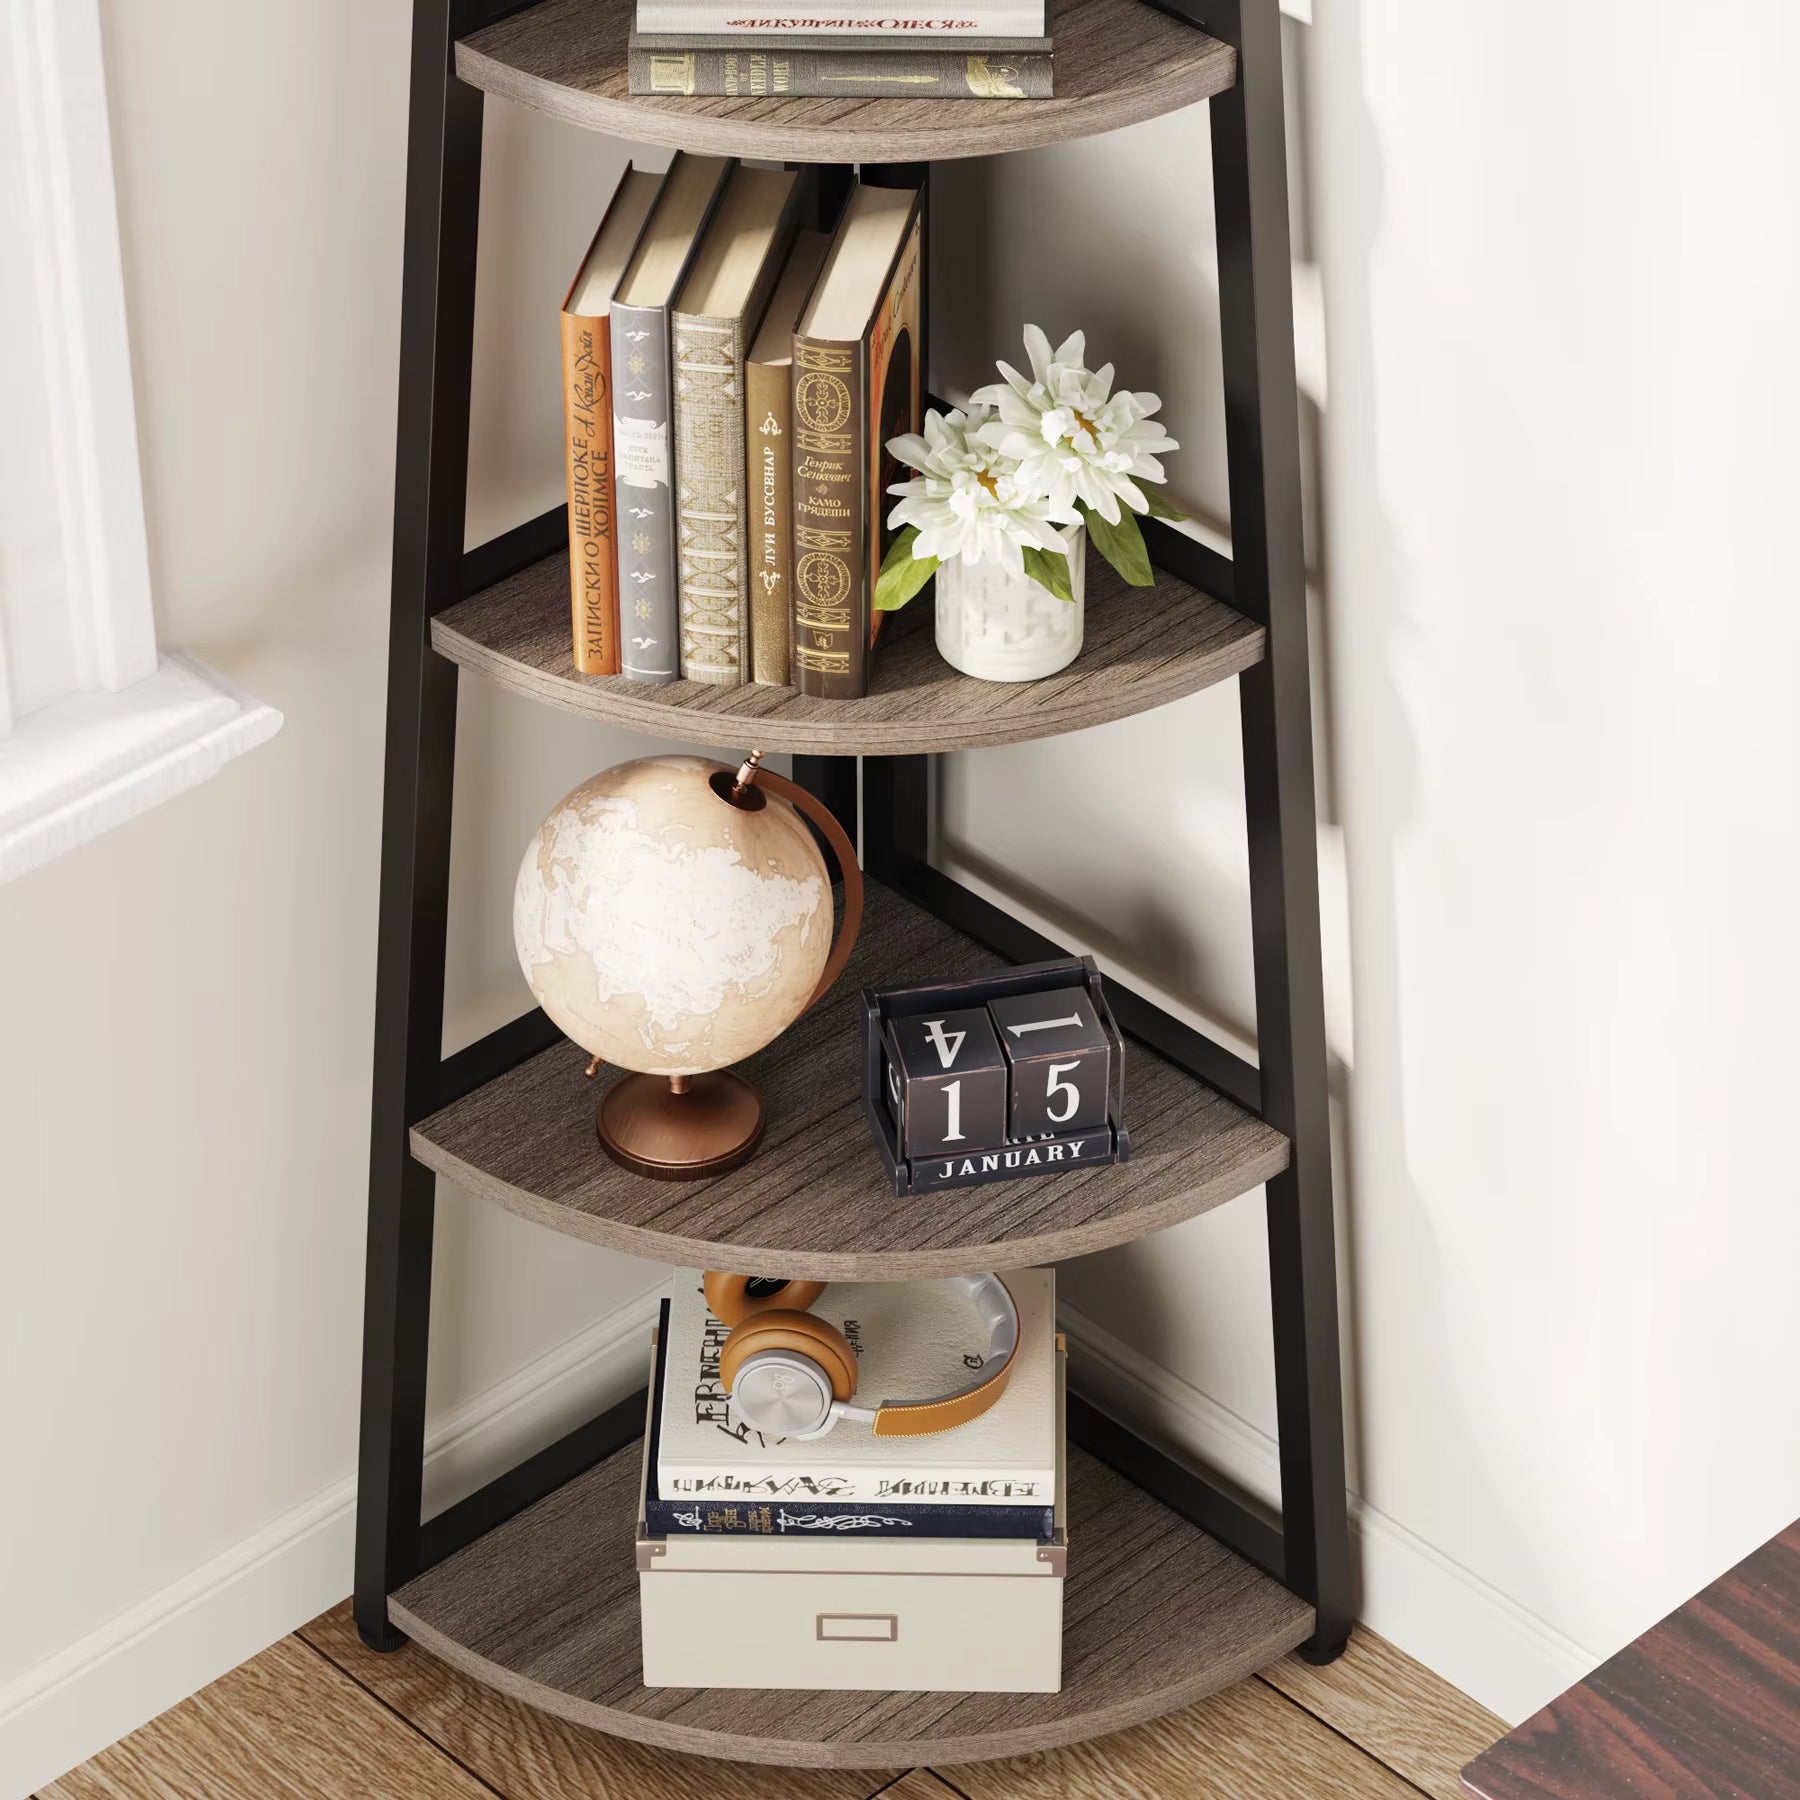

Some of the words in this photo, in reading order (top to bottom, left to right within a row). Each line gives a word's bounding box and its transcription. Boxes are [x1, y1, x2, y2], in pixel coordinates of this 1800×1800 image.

[774, 60, 789, 92] WORK
[797, 465, 851, 482] Сенкевич
[804, 455, 844, 472] Генрик
[573, 437, 591, 537] ШЕРЛОКЕ
[591, 451, 610, 540] ХОЛМСЕ
[763, 446, 776, 527] БУССЕНАР
[809, 496, 841, 507] КАМО
[798, 502, 850, 517] ГРЯДЕШИ
[765, 532, 776, 567] ЛУИ
[584, 560, 603, 660] ЗАПИСКИ
[921, 1019, 967, 1069] 4
[940, 1080, 967, 1142] 1
[1046, 1060, 1081, 1123] 5
[938, 1140, 1086, 1179] JANUARY
